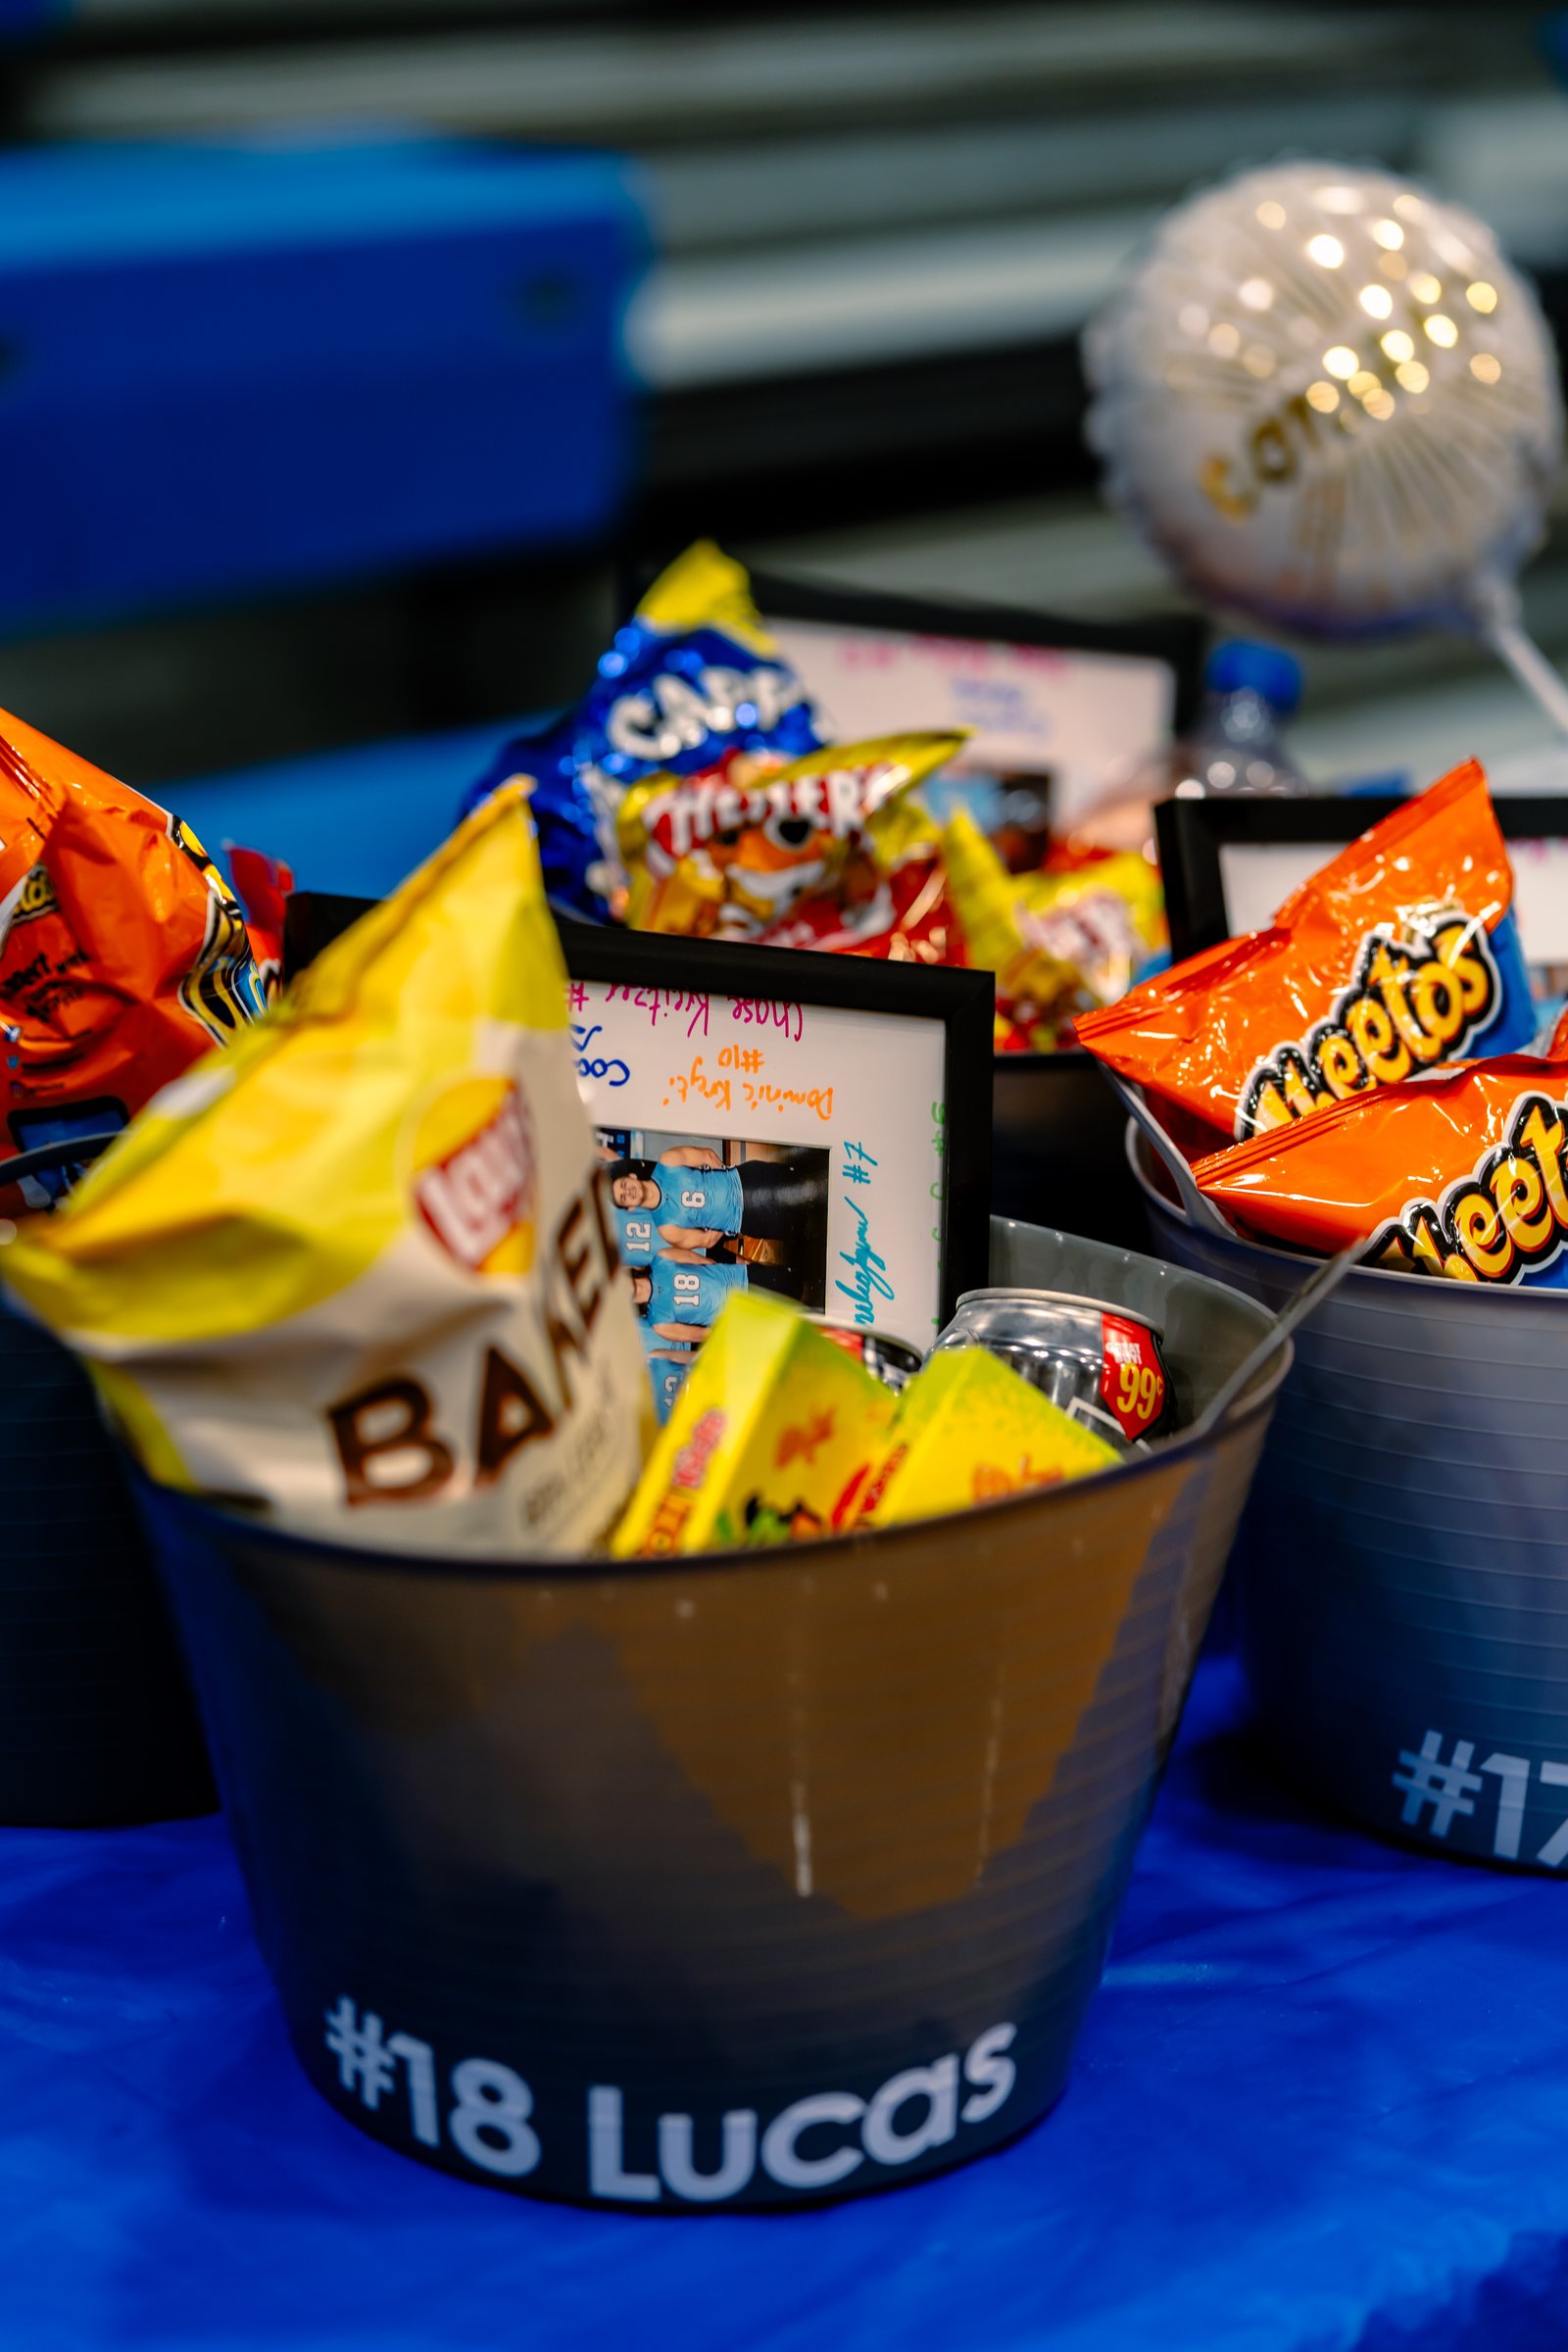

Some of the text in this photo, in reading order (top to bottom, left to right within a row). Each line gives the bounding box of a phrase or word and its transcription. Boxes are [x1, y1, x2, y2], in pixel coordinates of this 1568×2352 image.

[717, 1044, 765, 1074] #10
[741, 1082, 835, 1122] Dominic
[842, 1141, 878, 1185] #7
[681, 1191, 706, 1209] 6
[625, 1222, 652, 1253] 12
[673, 1273, 701, 1308] 18
[325, 1995, 1017, 2201] #18 Lucas
